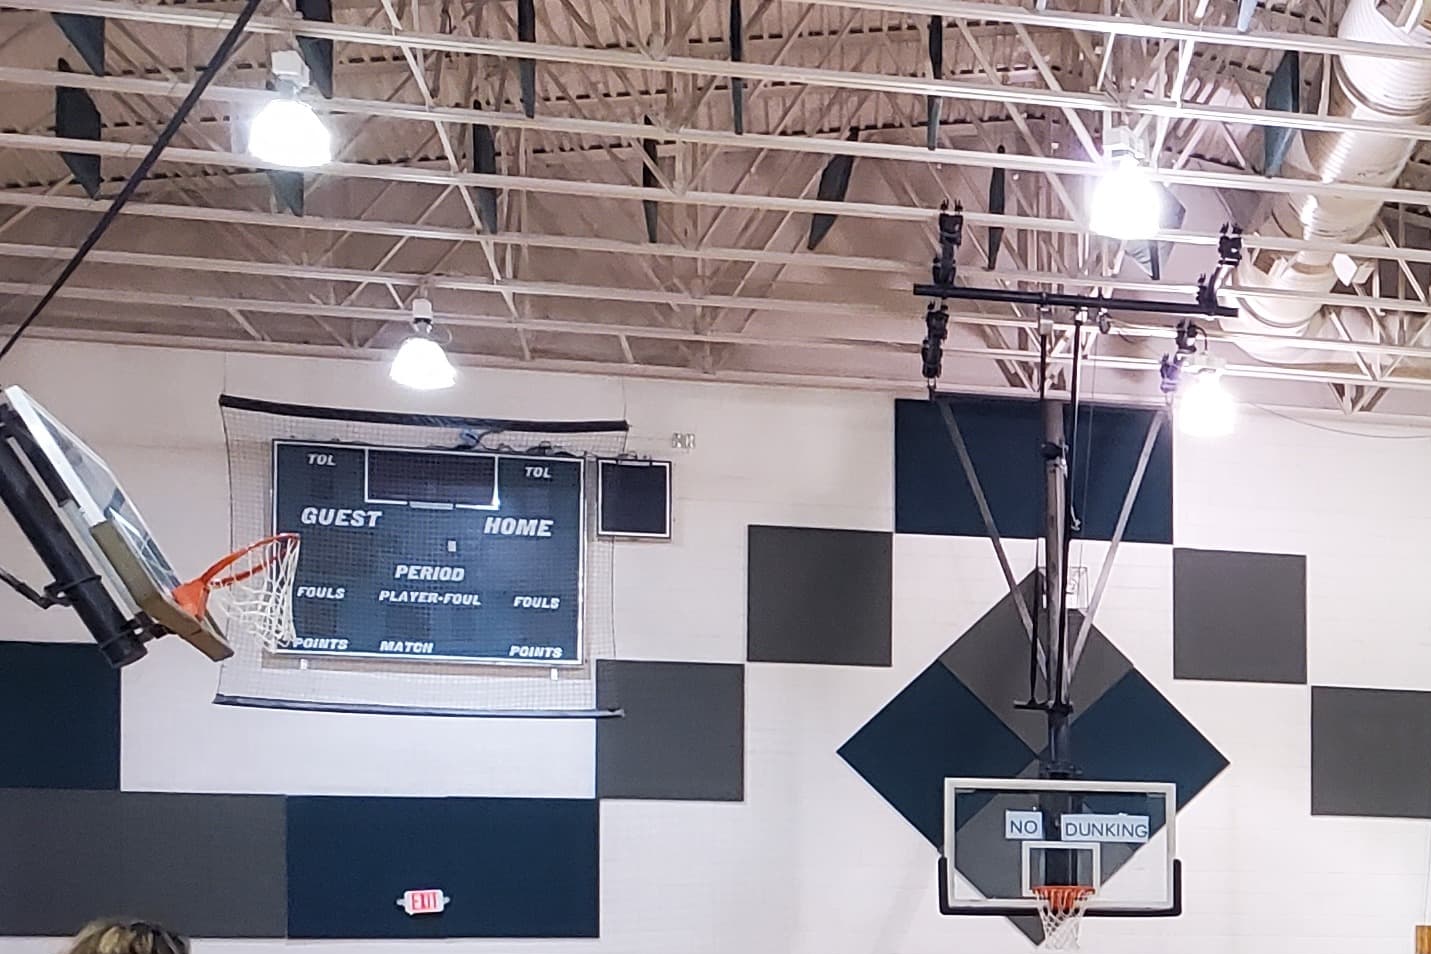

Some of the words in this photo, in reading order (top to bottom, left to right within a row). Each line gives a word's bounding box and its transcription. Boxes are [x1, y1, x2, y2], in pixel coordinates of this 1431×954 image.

[307, 453, 336, 466] TOL
[525, 466, 551, 478] TOL
[301, 507, 382, 527] GUEST
[483, 517, 554, 536] HOME
[395, 565, 464, 580] PERIOD
[297, 587, 345, 599] FOULS
[513, 596, 560, 609] FOULS
[293, 638, 348, 649] POINTS
[380, 641, 433, 653] MATCH
[509, 645, 563, 658] POINTS
[1010, 820, 1038, 834] NO
[1065, 822, 1147, 838] DUNKING
